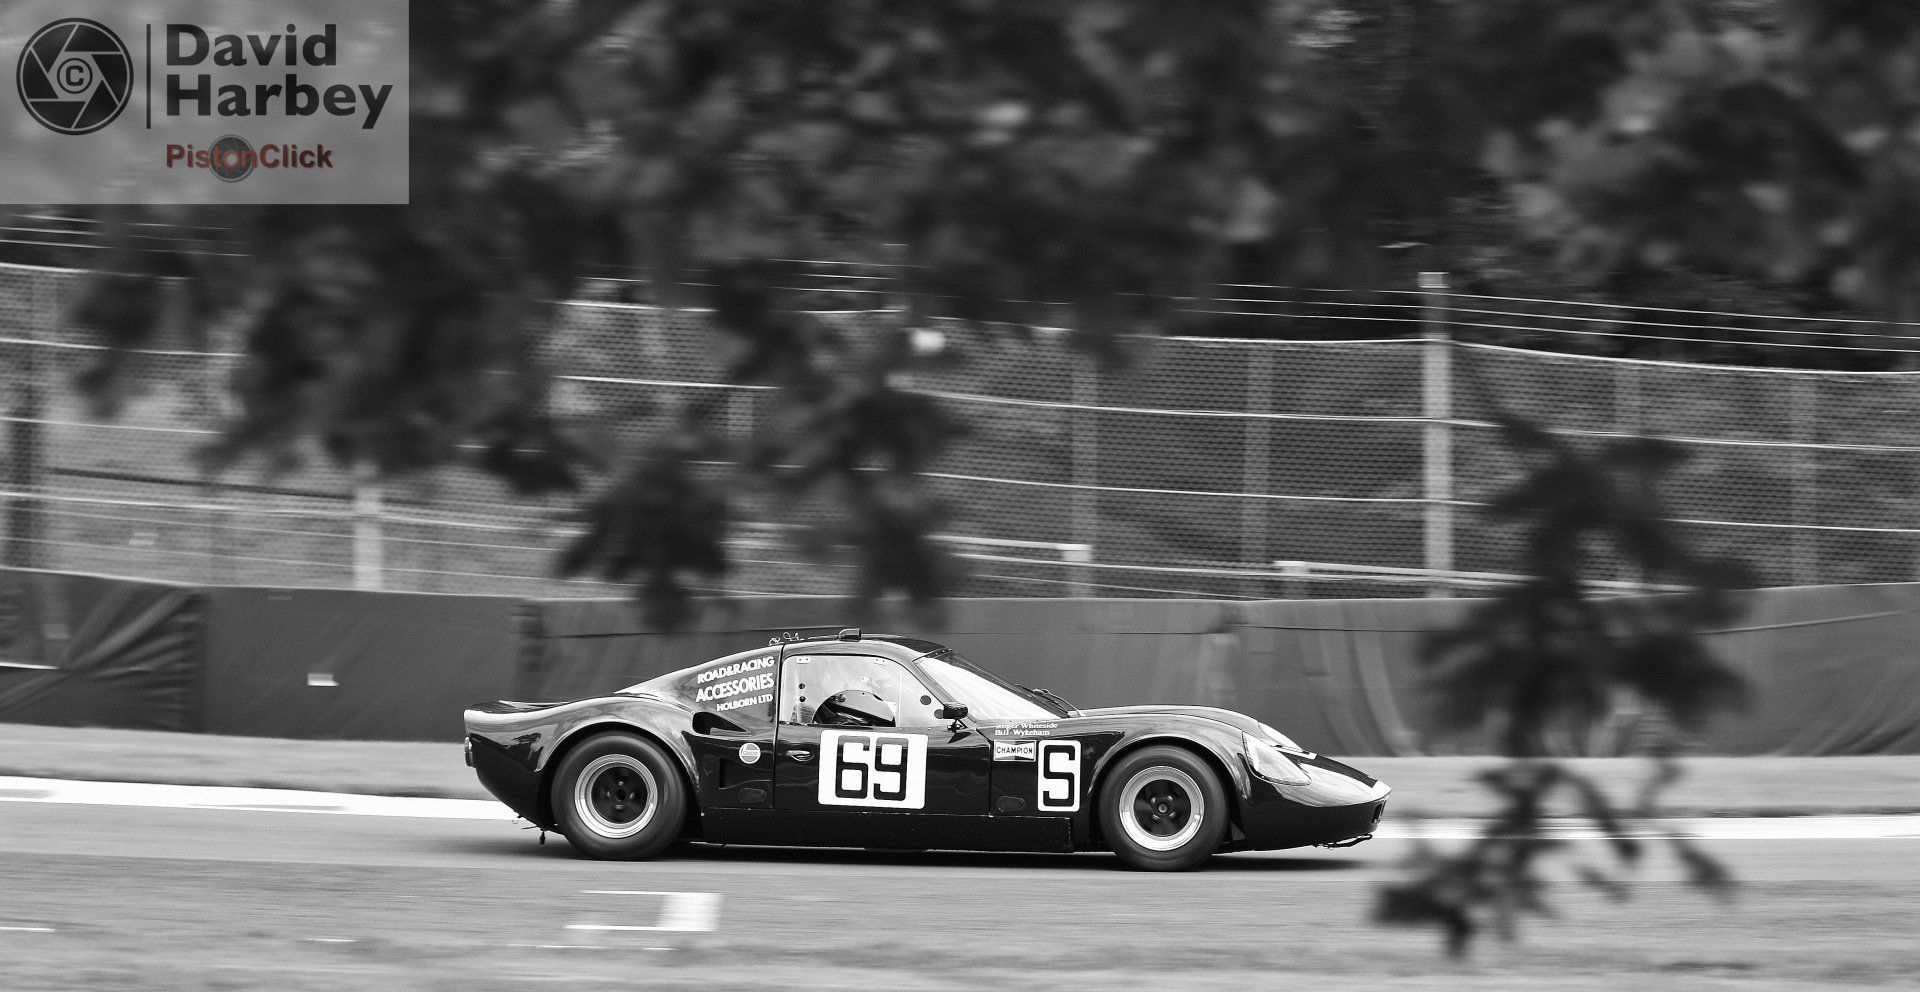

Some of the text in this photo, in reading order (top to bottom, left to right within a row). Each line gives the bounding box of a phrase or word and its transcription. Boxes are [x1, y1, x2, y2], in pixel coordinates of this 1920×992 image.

[698, 656, 775, 684] ROAD&RACING
[696, 673, 775, 702] ACCESSORIES
[717, 694, 773, 711] HOLBORN LTD
[996, 746, 1033, 754] CHAMPION
[835, 735, 909, 801] 69
[1043, 745, 1075, 807] S
